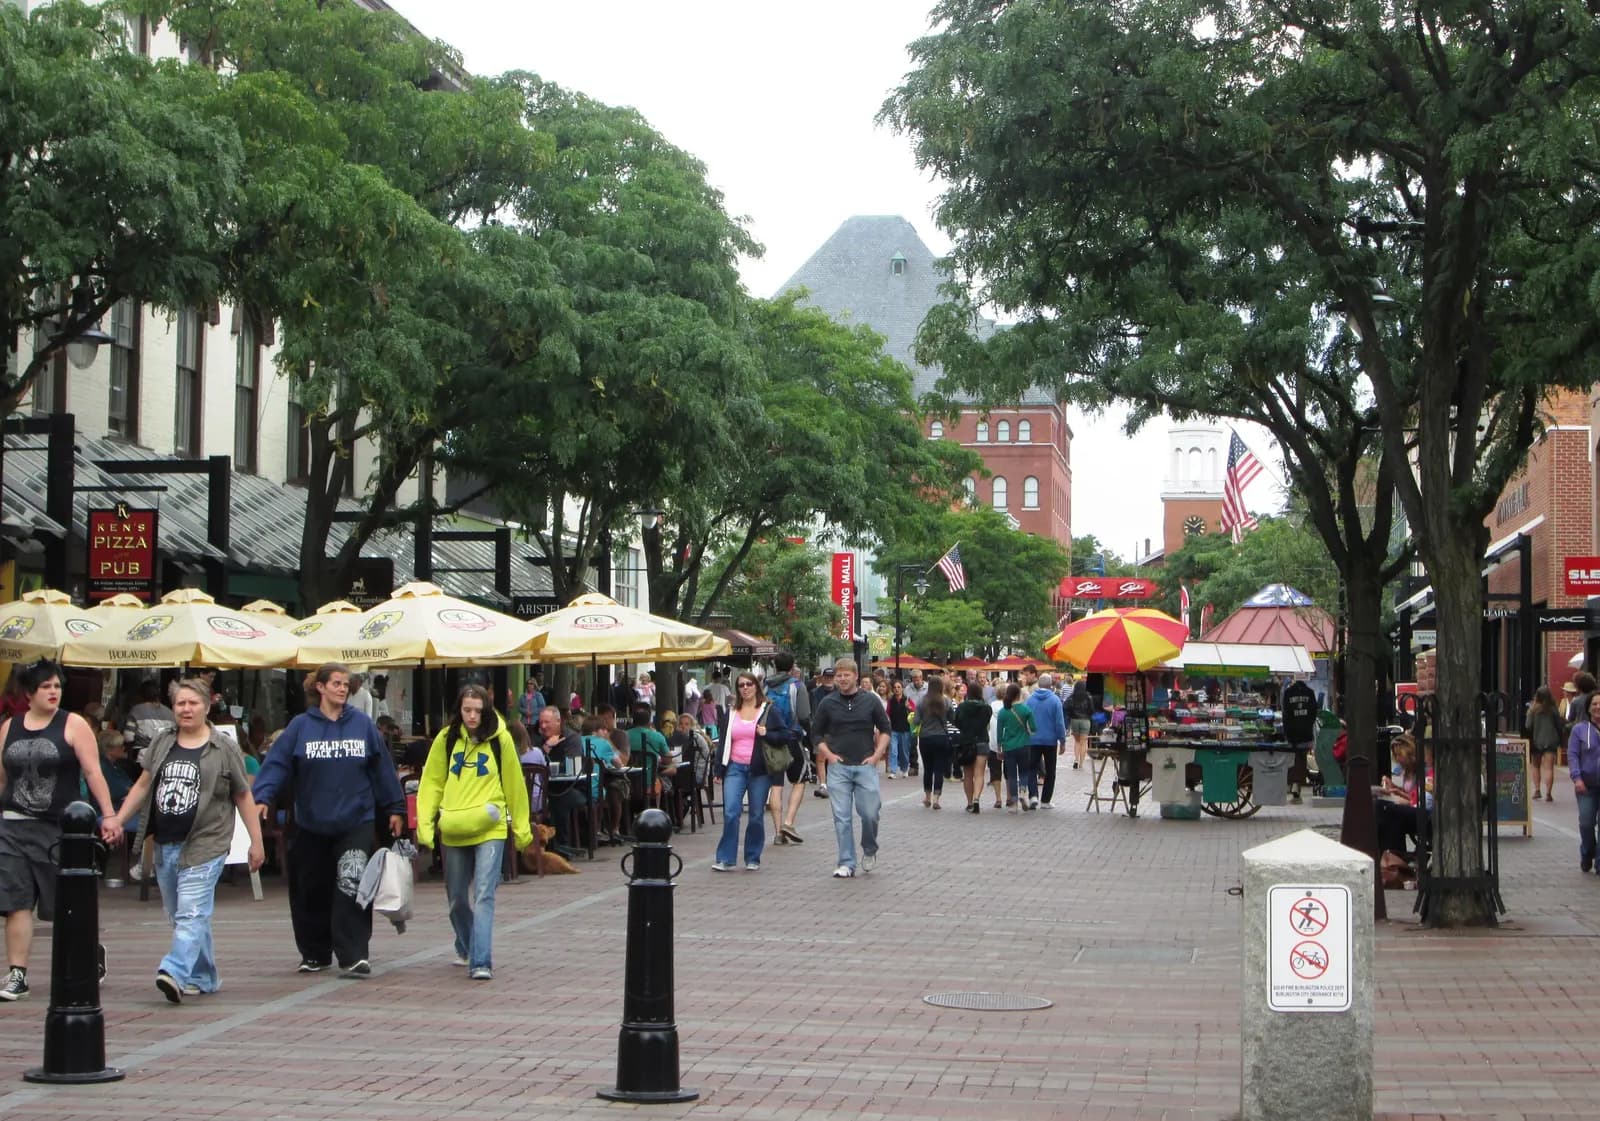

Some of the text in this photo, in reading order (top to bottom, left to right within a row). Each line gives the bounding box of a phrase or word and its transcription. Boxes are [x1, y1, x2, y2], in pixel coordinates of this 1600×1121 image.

[97, 523, 145, 532] KEN'S
[94, 535, 148, 549] PIZZA
[101, 561, 140, 575] PUB
[841, 556, 851, 584] MALL
[305, 739, 366, 751] BURLINGTON
